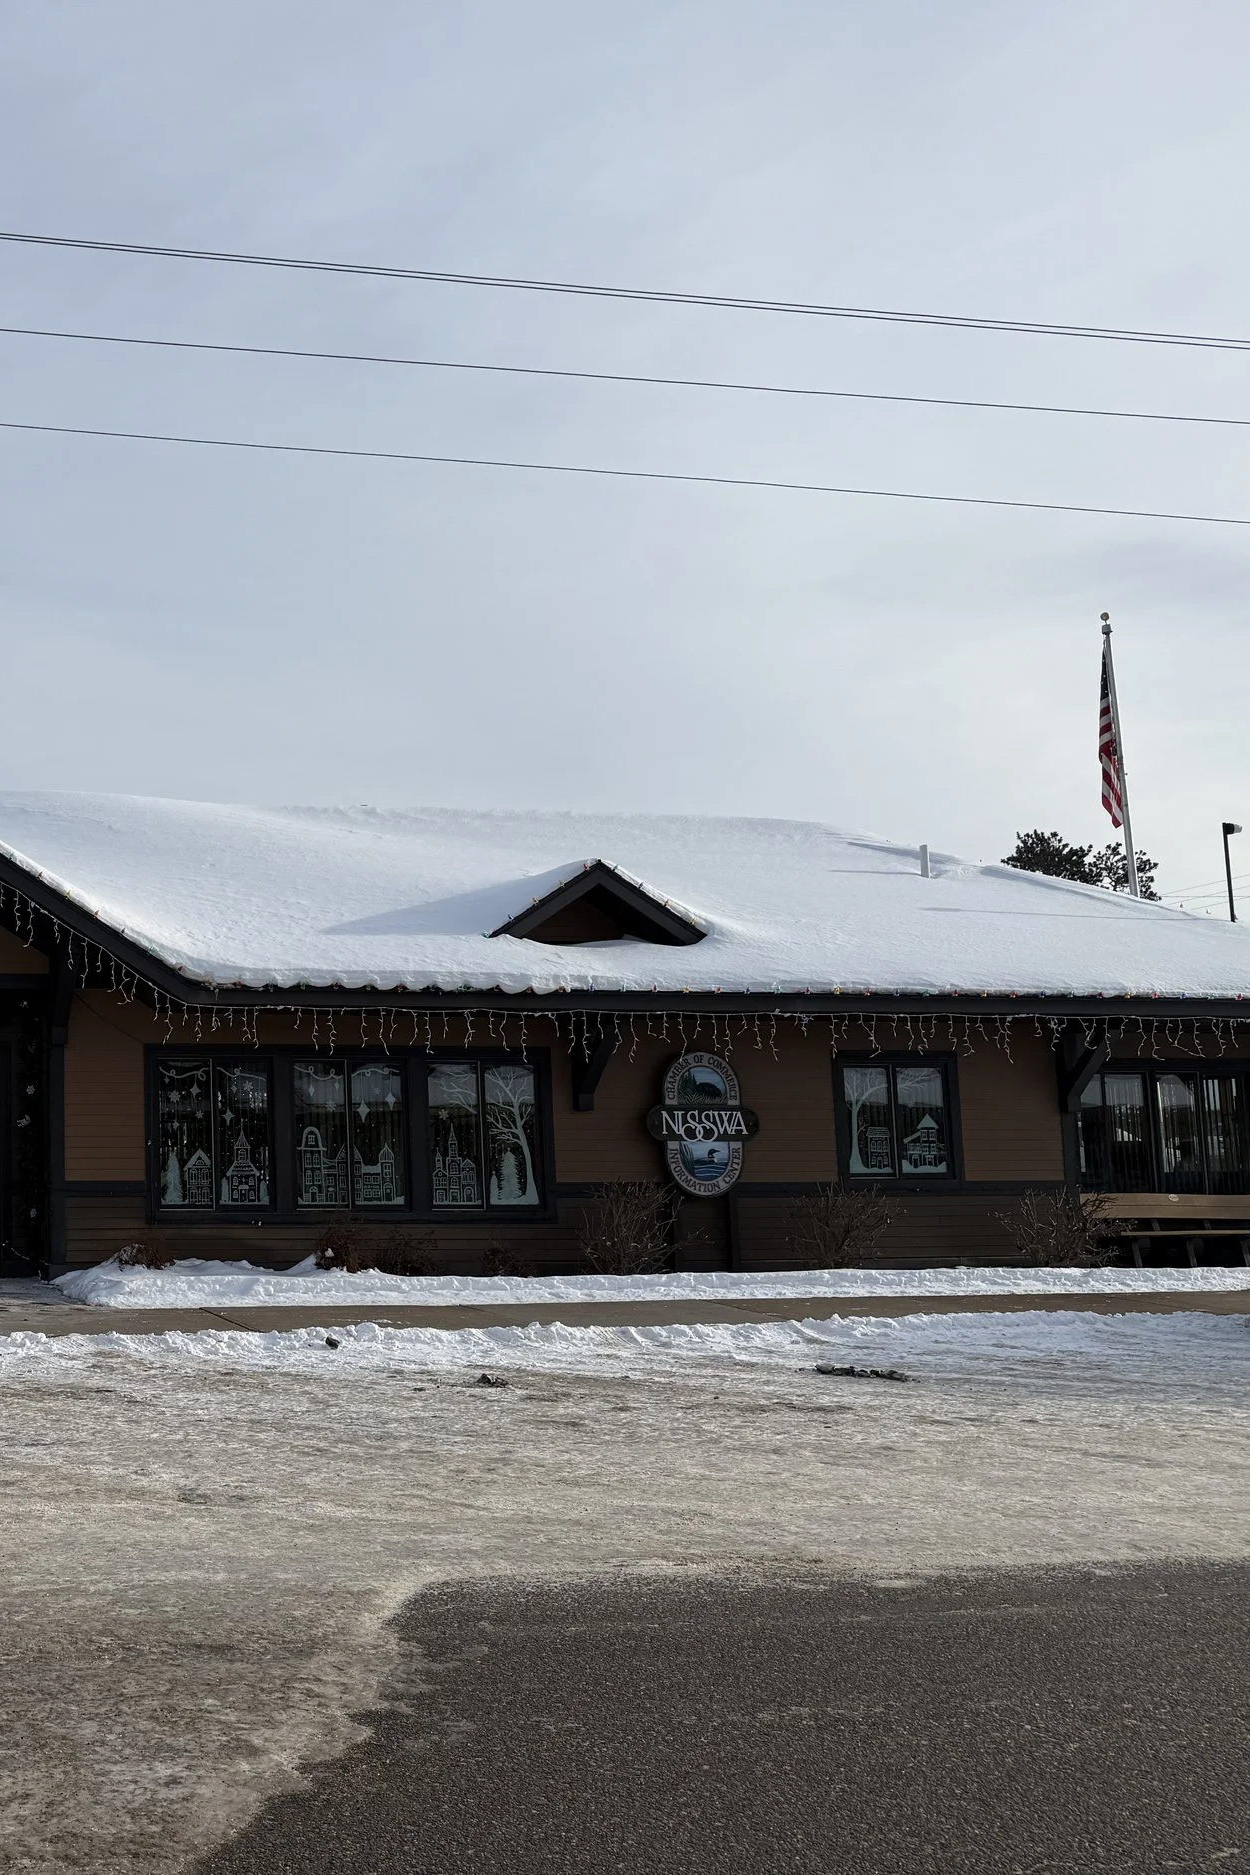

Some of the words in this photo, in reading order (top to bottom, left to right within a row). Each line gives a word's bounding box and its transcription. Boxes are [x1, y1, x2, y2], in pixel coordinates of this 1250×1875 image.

[667, 1057, 691, 1100] CHAMBER
[693, 1055, 705, 1064] OF
[708, 1056, 738, 1101] COMMERCE
[661, 1109, 748, 1142] NISSWA
[668, 1148, 721, 1192] INFORMATION
[724, 1147, 741, 1188] CENTER
